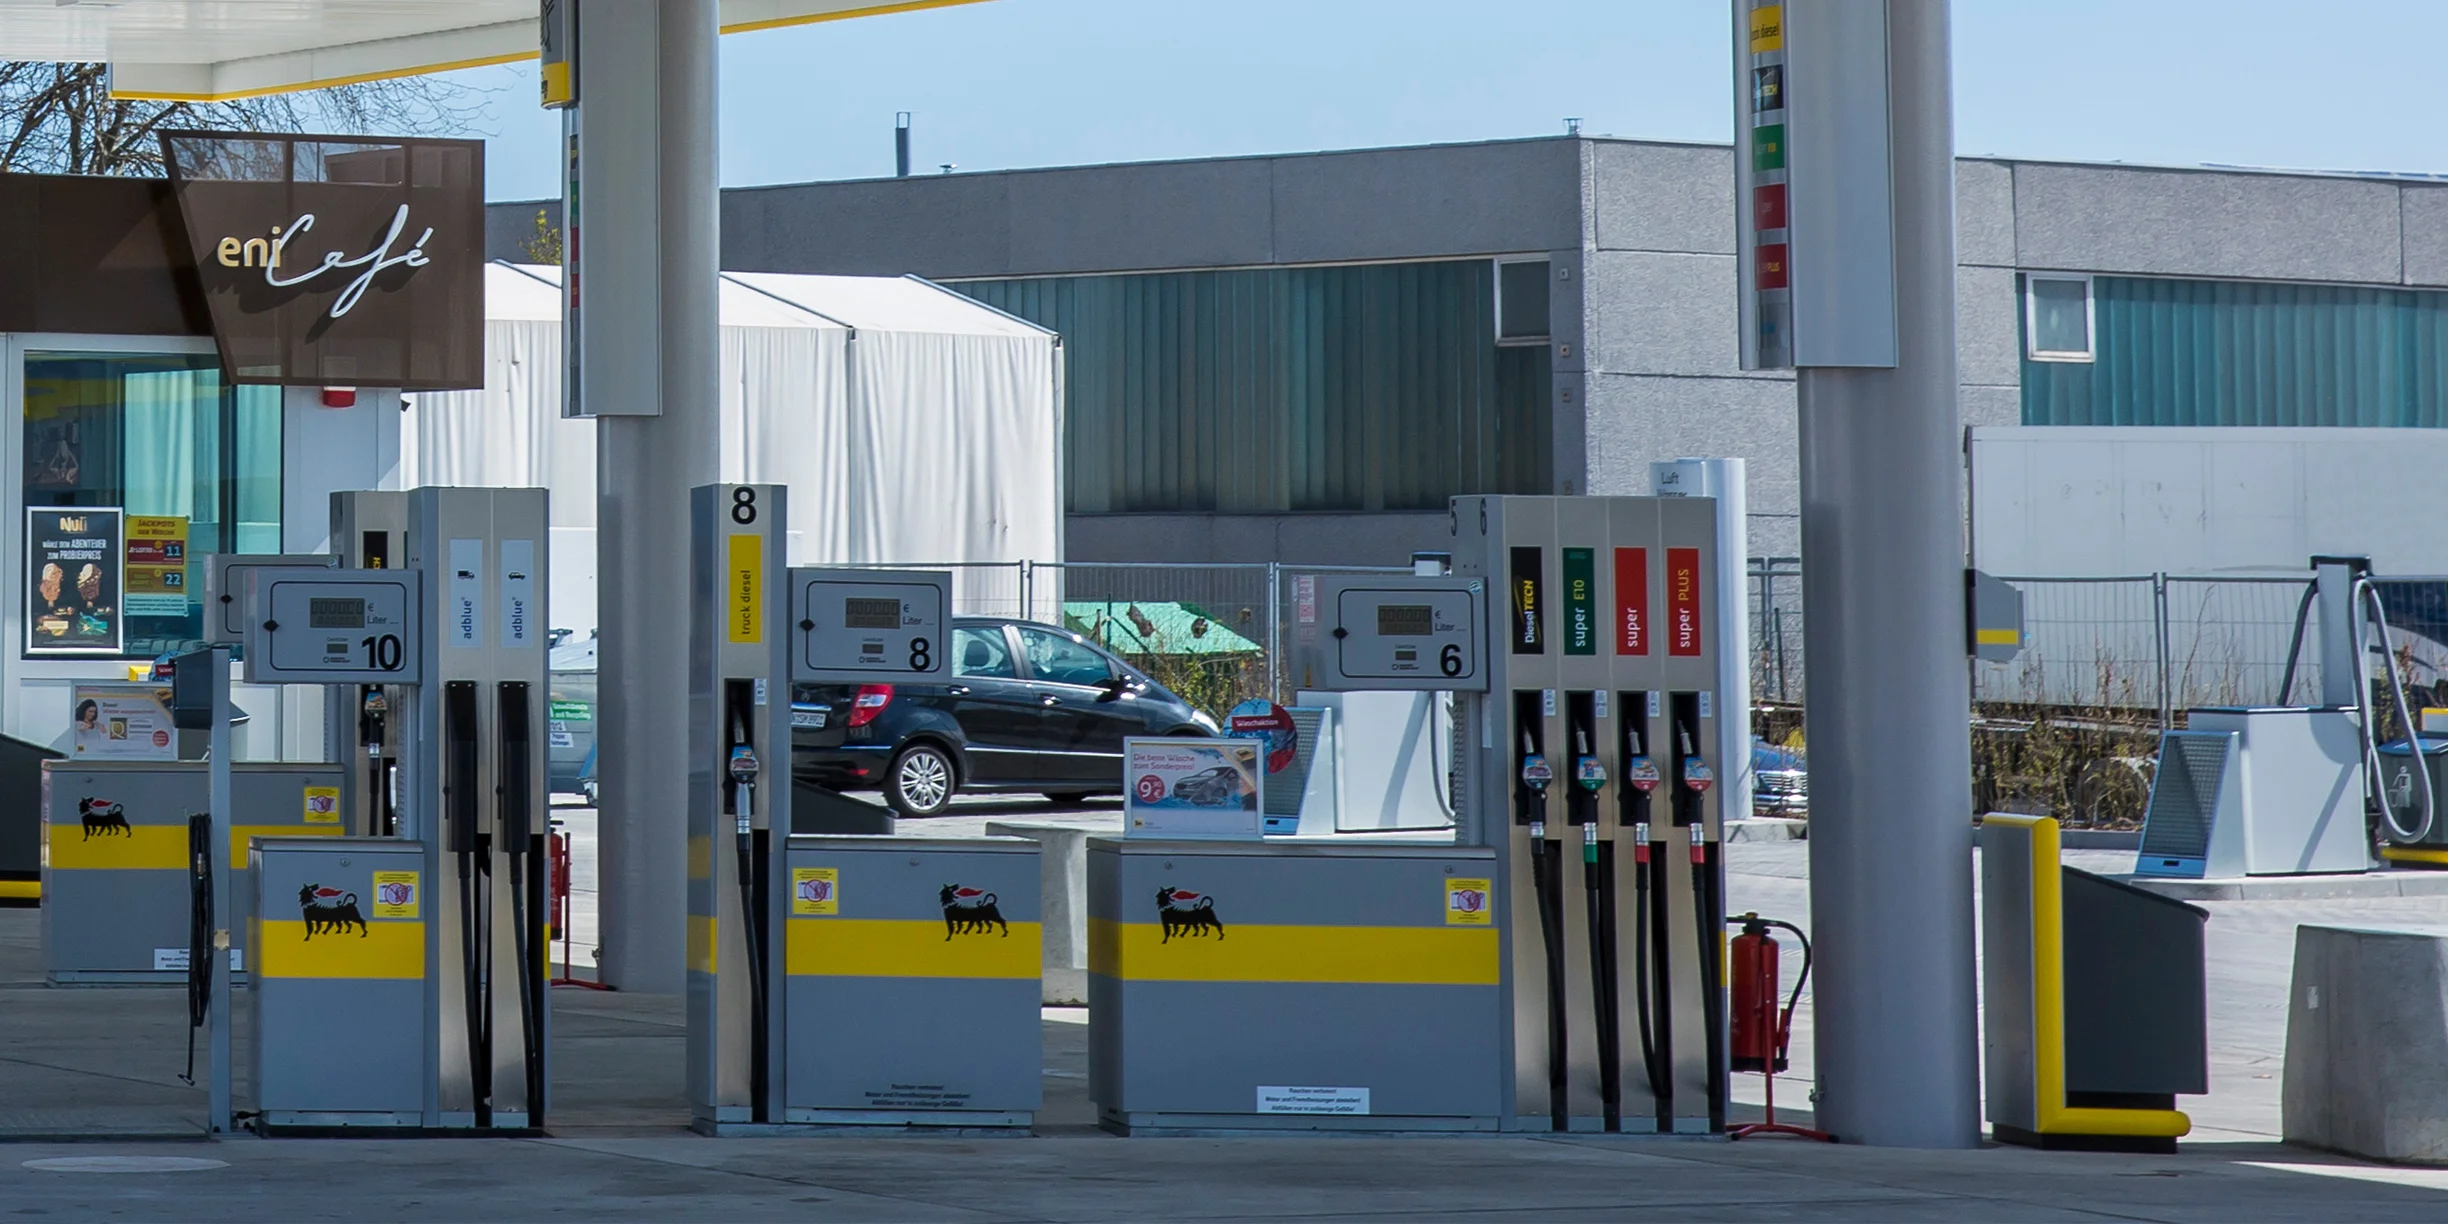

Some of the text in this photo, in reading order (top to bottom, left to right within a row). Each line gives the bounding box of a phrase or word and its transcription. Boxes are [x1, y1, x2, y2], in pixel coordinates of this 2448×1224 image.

[217, 203, 434, 318] eni Café
[731, 486, 757, 525] 8
[1480, 497, 1488, 537] 6
[165, 545, 181, 557] 11
[165, 573, 181, 585] 22
[366, 615, 388, 625] Liter
[741, 569, 751, 636] truck diesel
[902, 616, 923, 625] Liter
[1573, 579, 1589, 647] super E10
[1677, 568, 1694, 648] super PLUS
[1434, 623, 1455, 632] Liter
[1626, 607, 1641, 647] super
[361, 633, 402, 671] 10
[909, 637, 931, 671] 8
[1440, 643, 1463, 677] 6
[1235, 719, 1279, 727] Waschaktion
